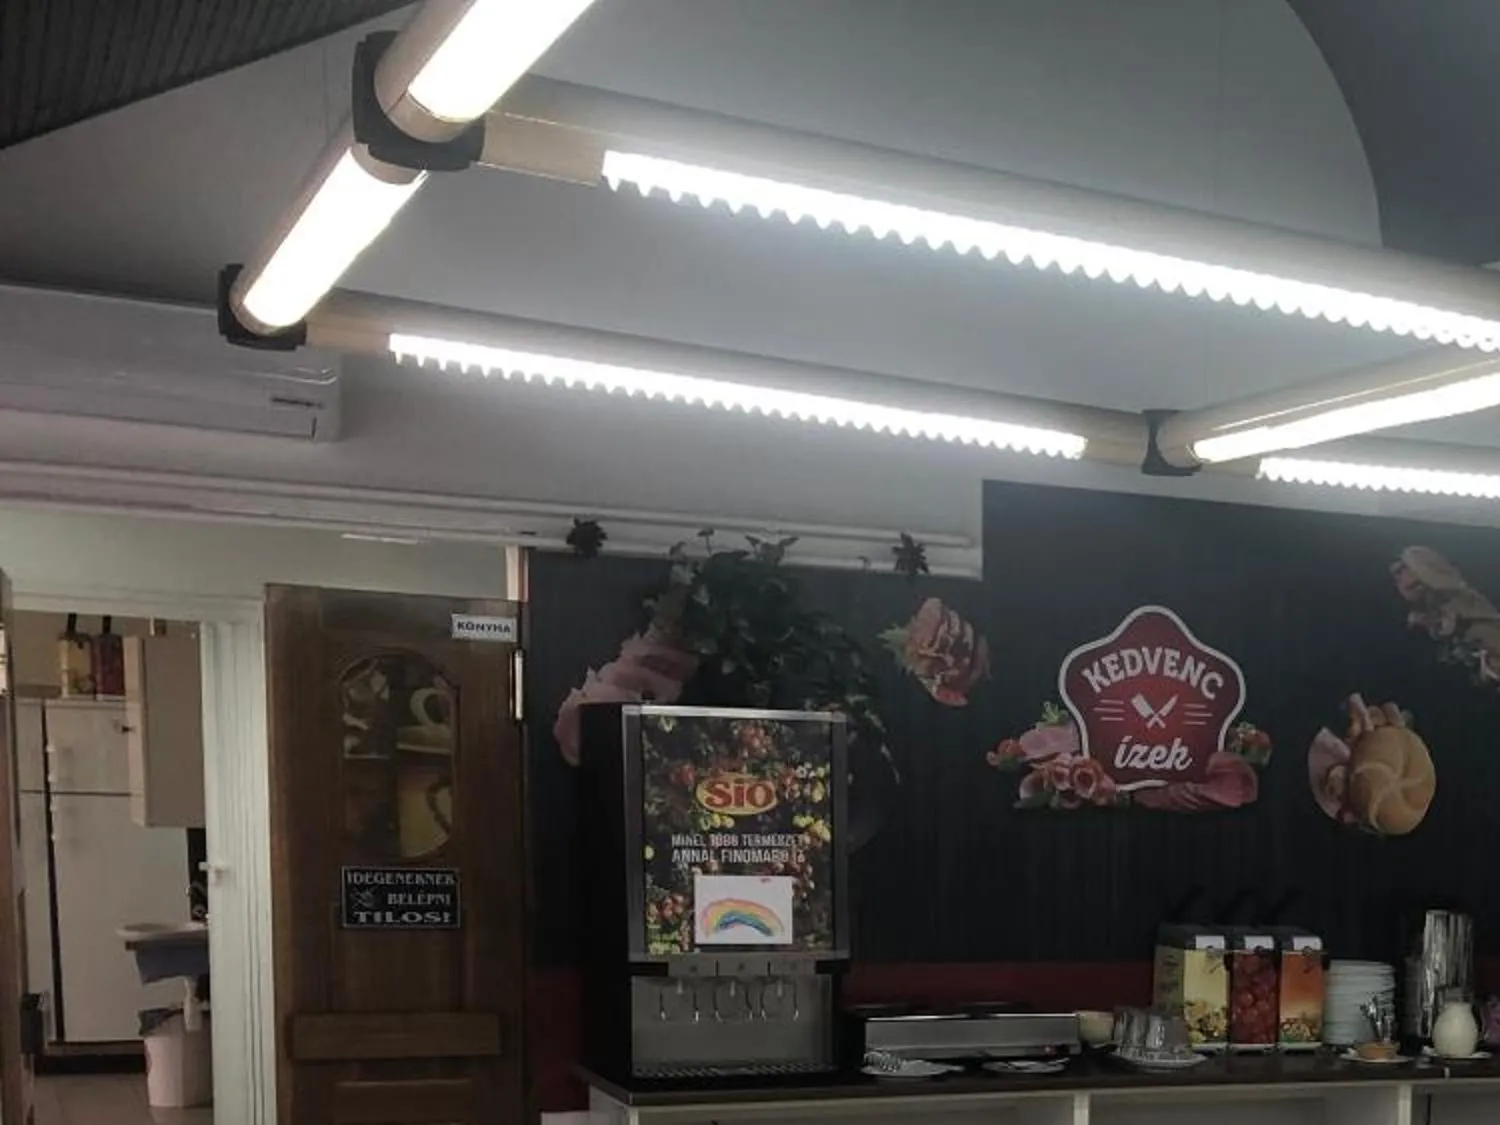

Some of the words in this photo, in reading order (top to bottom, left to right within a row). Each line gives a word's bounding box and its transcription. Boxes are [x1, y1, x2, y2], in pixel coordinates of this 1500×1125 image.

[1080, 646, 1225, 700] KEDVENC
[1114, 735, 1193, 771] ízek
[353, 911, 452, 924] TILOS!
